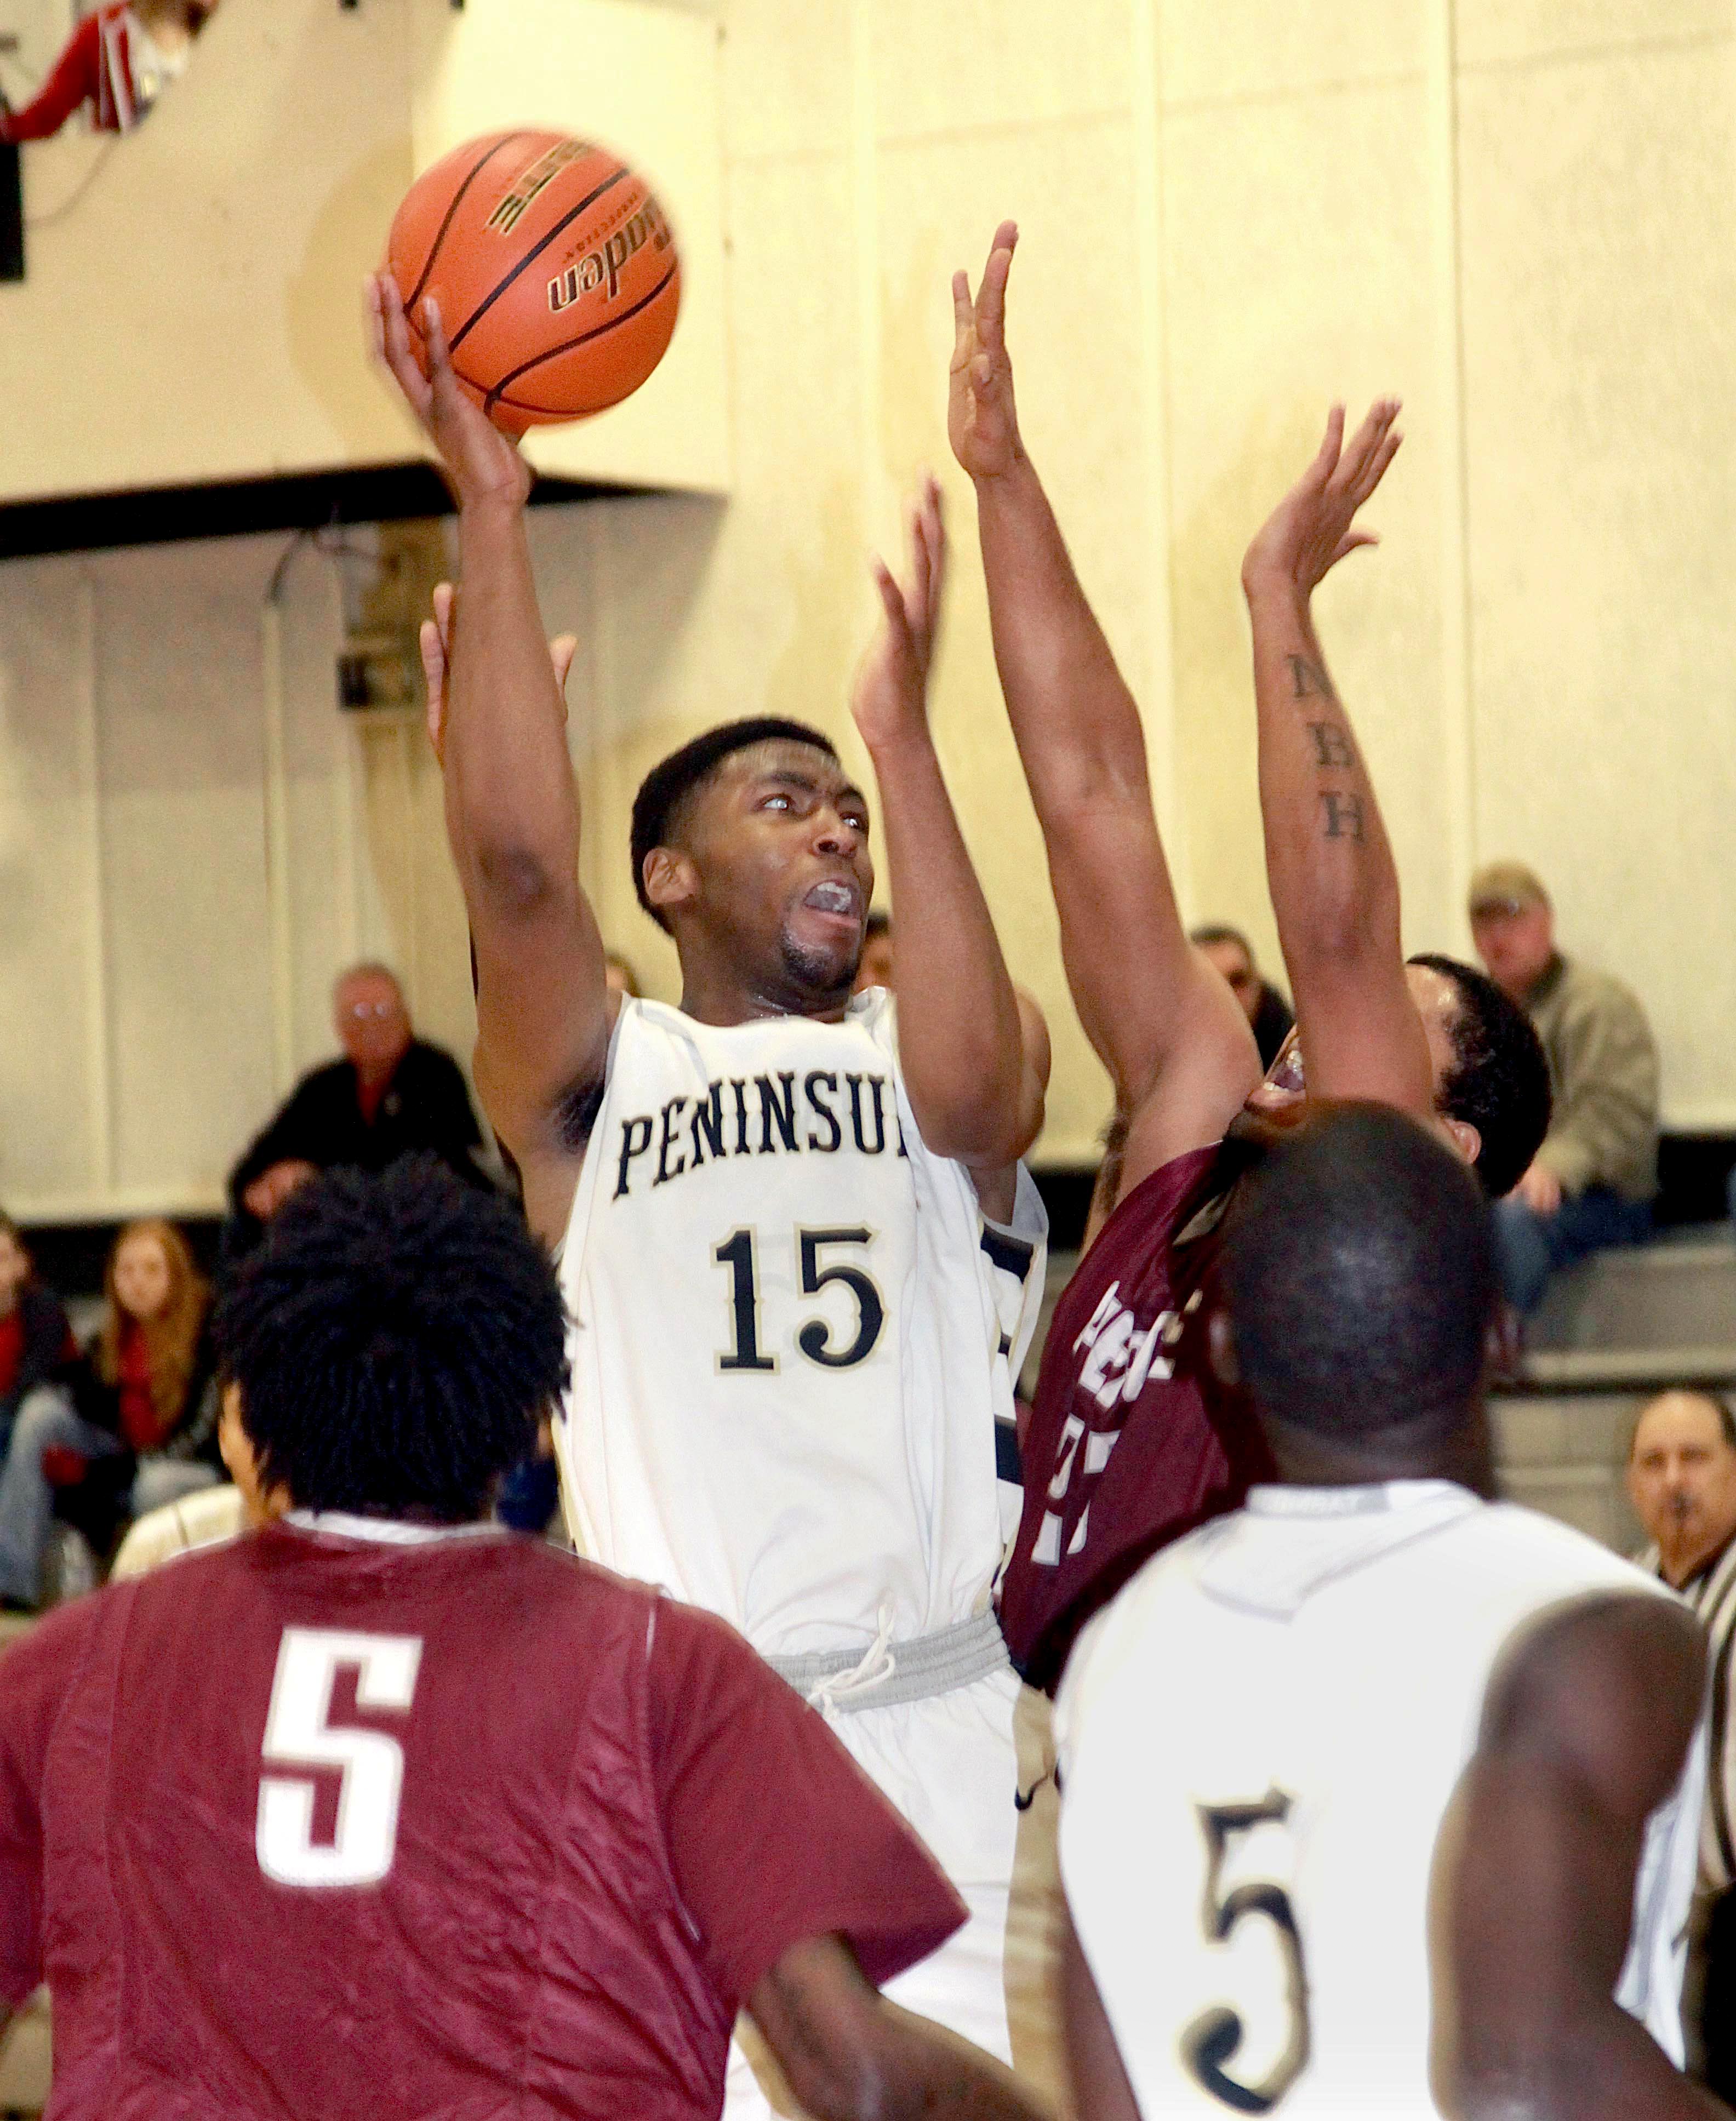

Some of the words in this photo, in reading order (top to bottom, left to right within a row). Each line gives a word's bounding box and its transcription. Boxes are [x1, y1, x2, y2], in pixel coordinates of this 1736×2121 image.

[612, 1070, 910, 1201] PENINSU
[712, 1224, 890, 1374] 15
[256, 1625, 425, 1888] 5
[1178, 1783, 1312, 2116] 5
